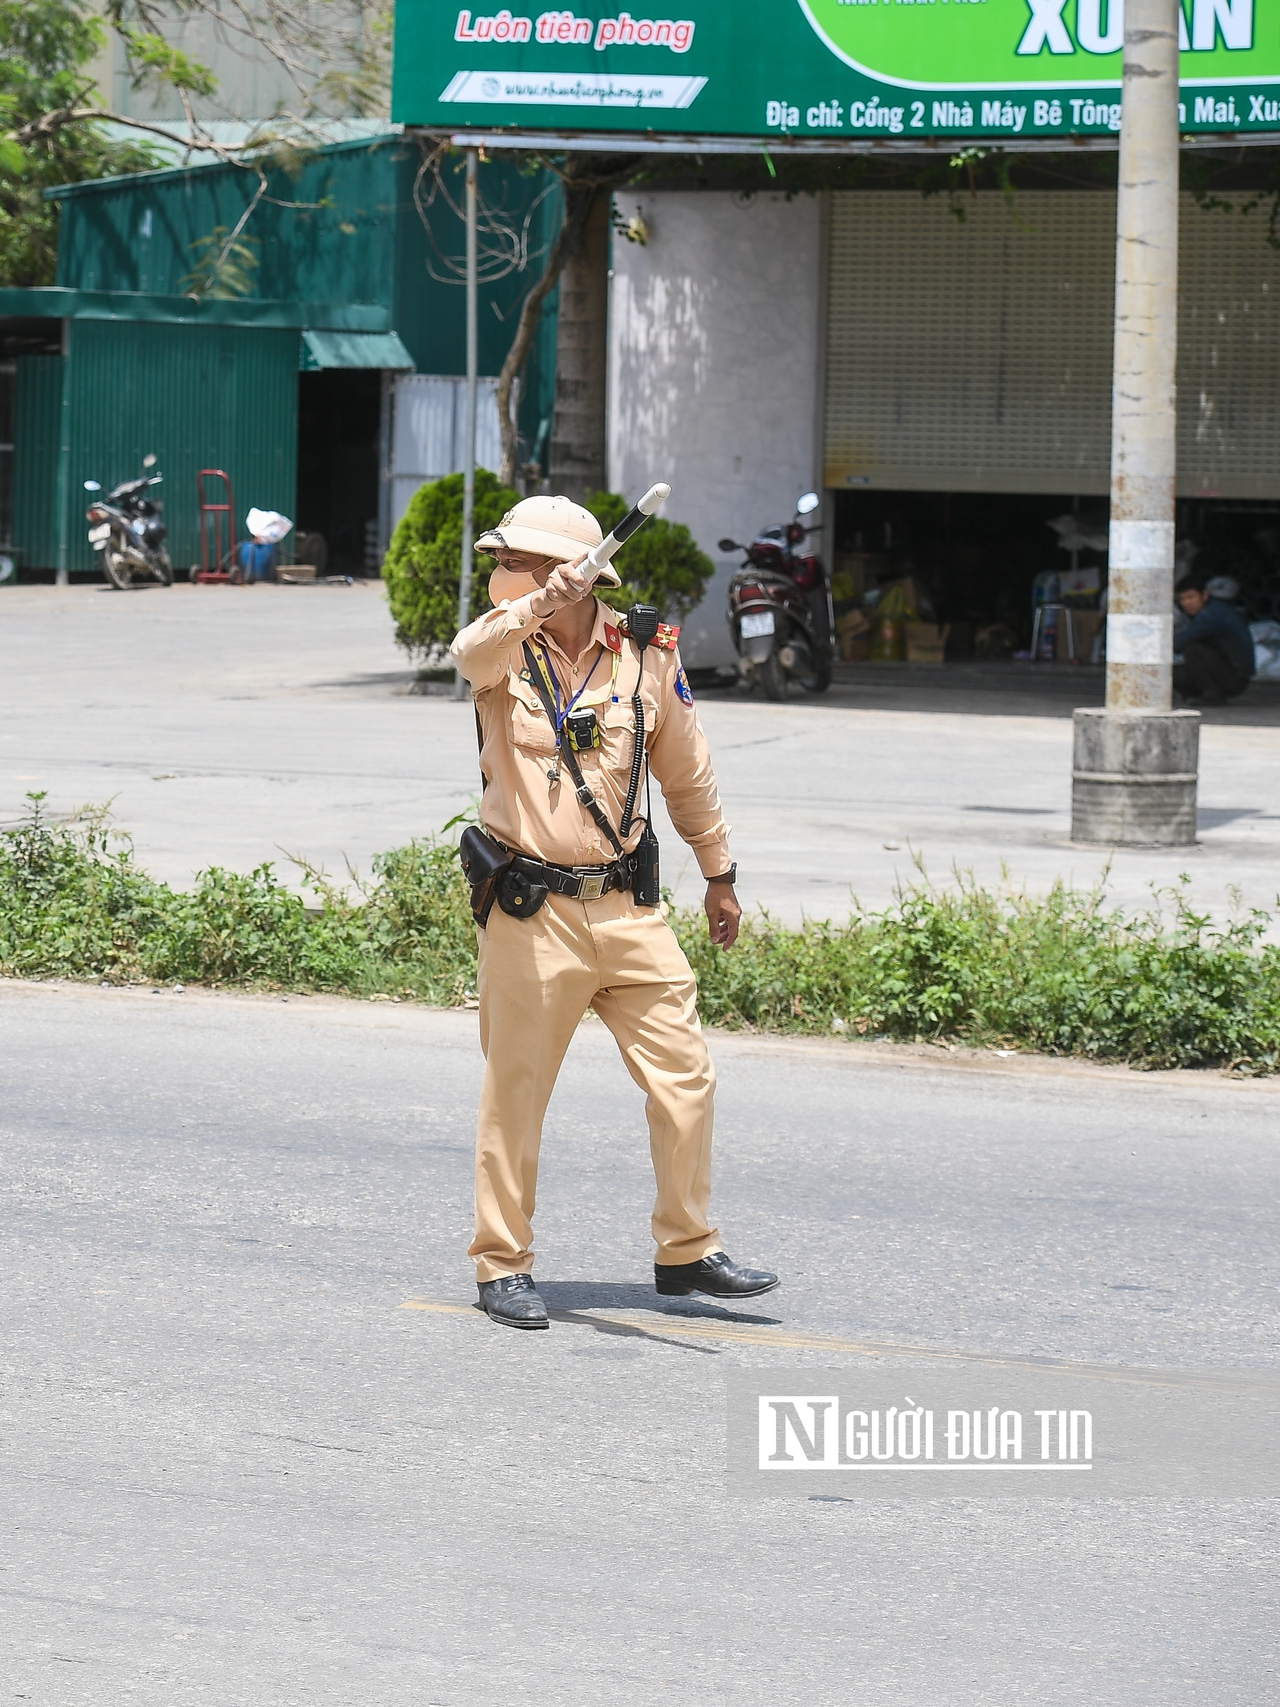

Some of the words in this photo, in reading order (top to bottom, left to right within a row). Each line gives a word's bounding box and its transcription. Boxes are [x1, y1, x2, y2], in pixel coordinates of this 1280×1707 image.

[455, 10, 531, 42] Luôn
[536, 11, 593, 43] tiên
[594, 12, 695, 53] phong
[1016, 0, 1252, 54] XUN
[766, 101, 800, 132] Địa
[850, 96, 904, 133] Cổng
[910, 102, 925, 127] 2
[932, 101, 974, 127] Nhà
[981, 100, 1027, 132] Máy
[1033, 99, 1063, 126] Bê
[1070, 98, 1122, 131] Tông
[1194, 95, 1241, 126] Mai,
